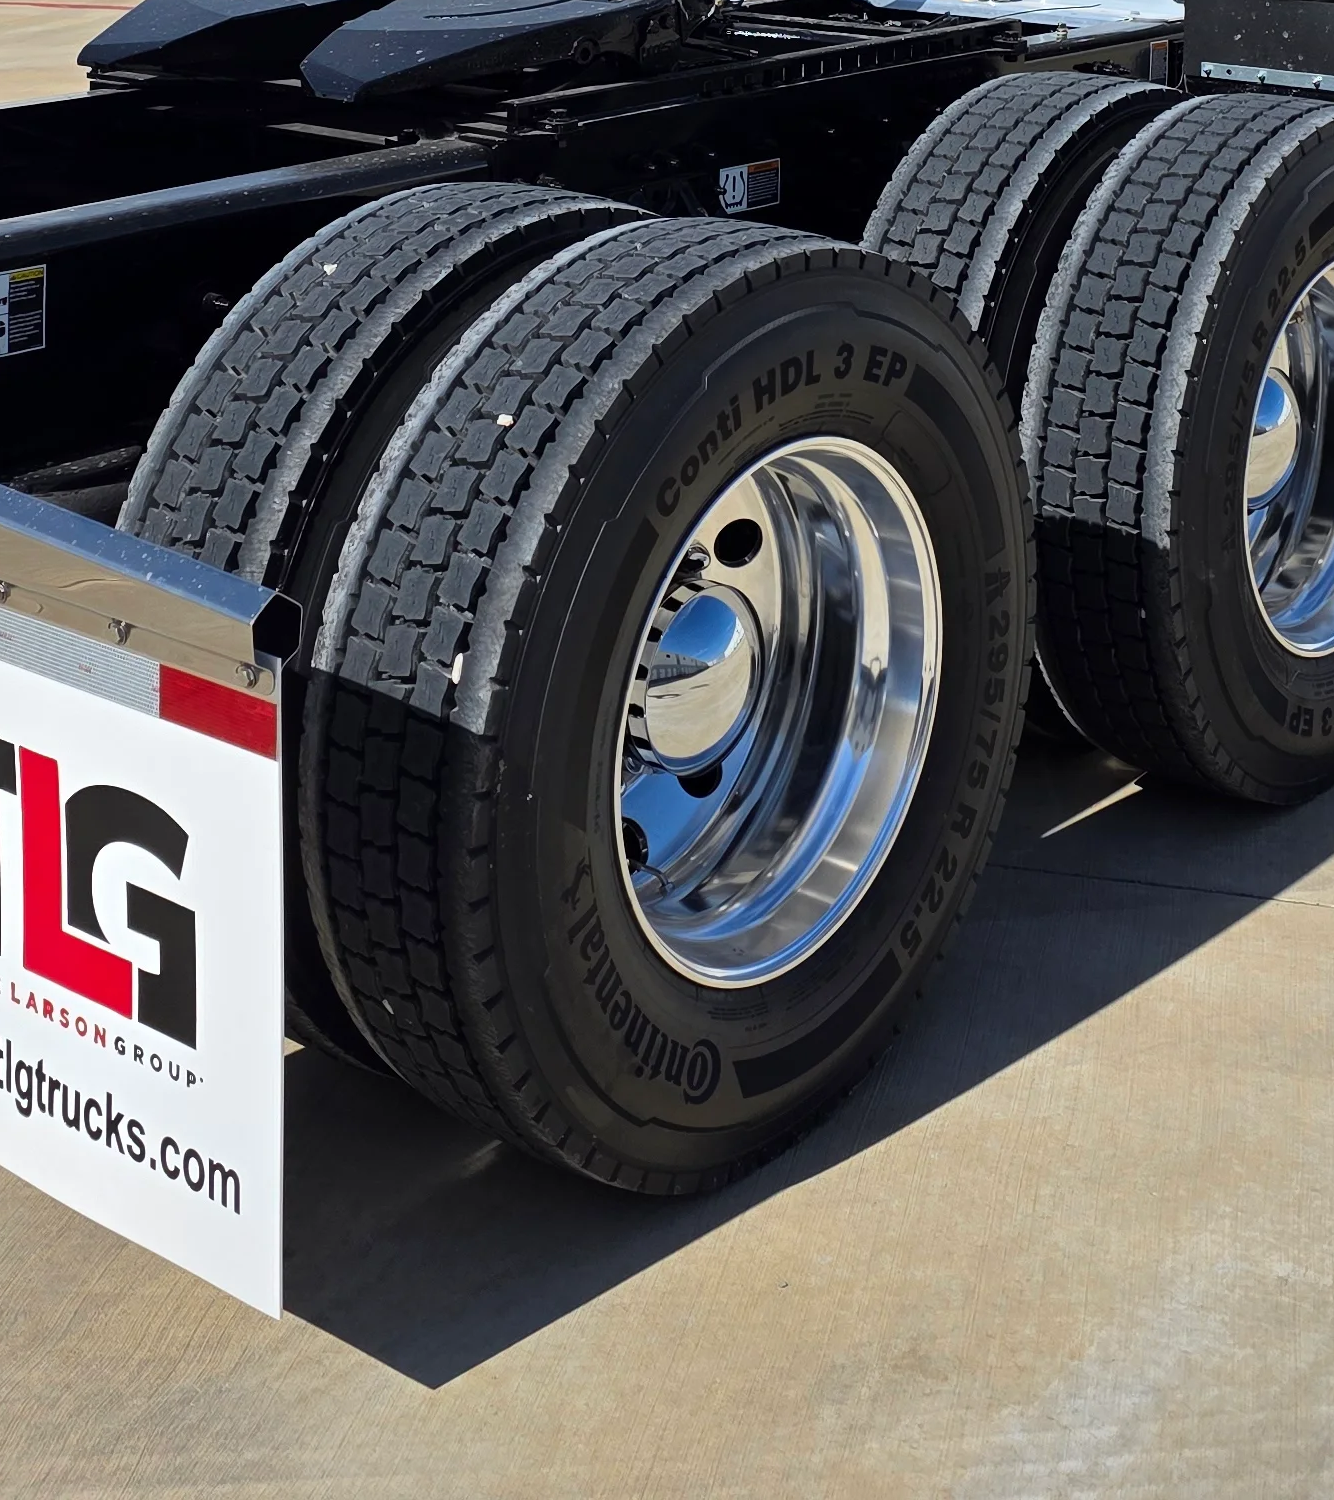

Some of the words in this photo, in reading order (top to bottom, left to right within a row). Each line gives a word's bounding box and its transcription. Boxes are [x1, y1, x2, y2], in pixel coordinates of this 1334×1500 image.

[1267, 240, 1308, 319] 22.5
[655, 393, 743, 518] Conti
[751, 349, 822, 414] HDL
[833, 341, 856, 380] 3
[862, 345, 909, 388] EP
[974, 609, 1011, 792] 295/75
[1288, 704, 1315, 738] EP
[1320, 706, 1334, 737] 3
[951, 800, 977, 840] R
[898, 845, 959, 957] 22.5
[9, 982, 108, 1048] LARSON
[113, 1037, 200, 1089] GROUP
[567, 896, 722, 1106] Continental
